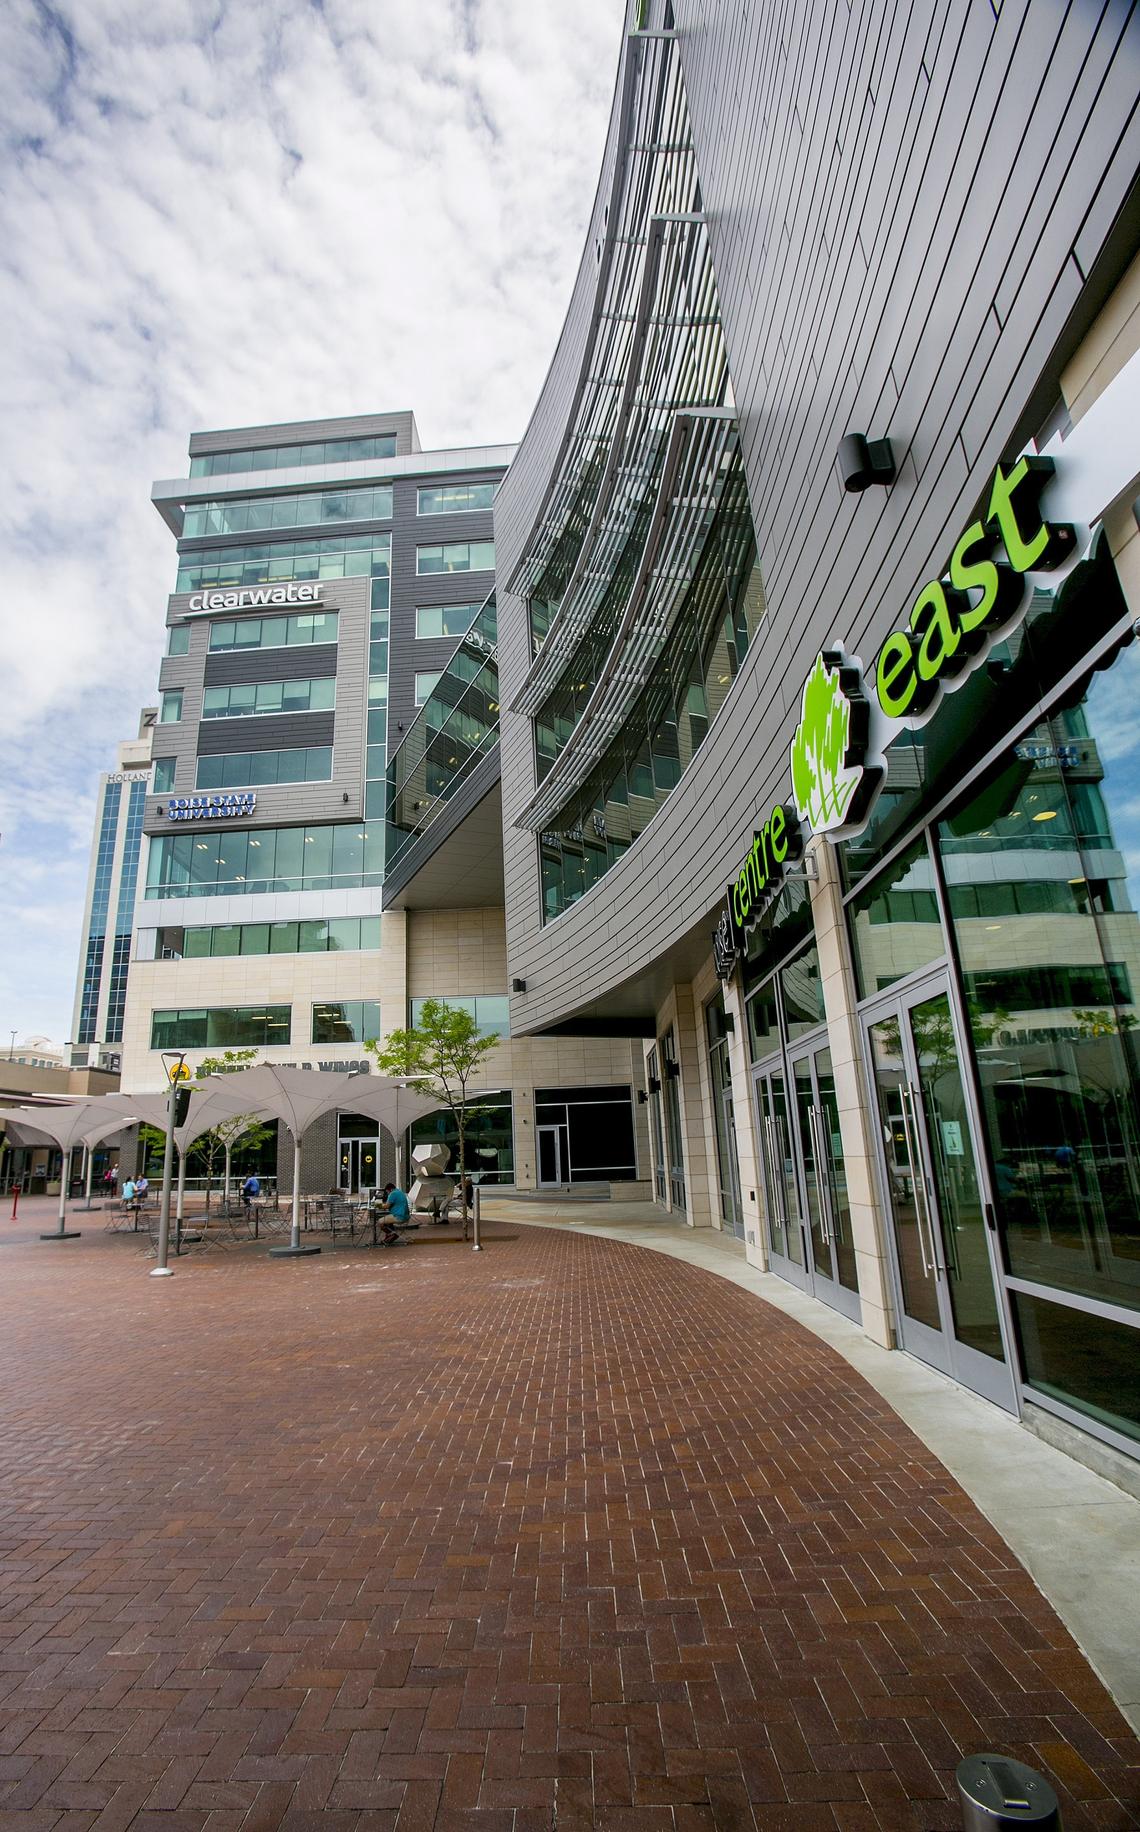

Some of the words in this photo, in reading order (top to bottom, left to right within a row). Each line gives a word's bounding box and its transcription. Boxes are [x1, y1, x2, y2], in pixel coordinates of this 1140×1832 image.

[188, 583, 325, 611] clearwater
[733, 804, 789, 928] centre
[876, 456, 1051, 718] east
[168, 797, 210, 810] BOISE
[213, 793, 257, 807] STATE
[168, 804, 257, 821] UNIVERSITY
[317, 1060, 370, 1075] WINGS
